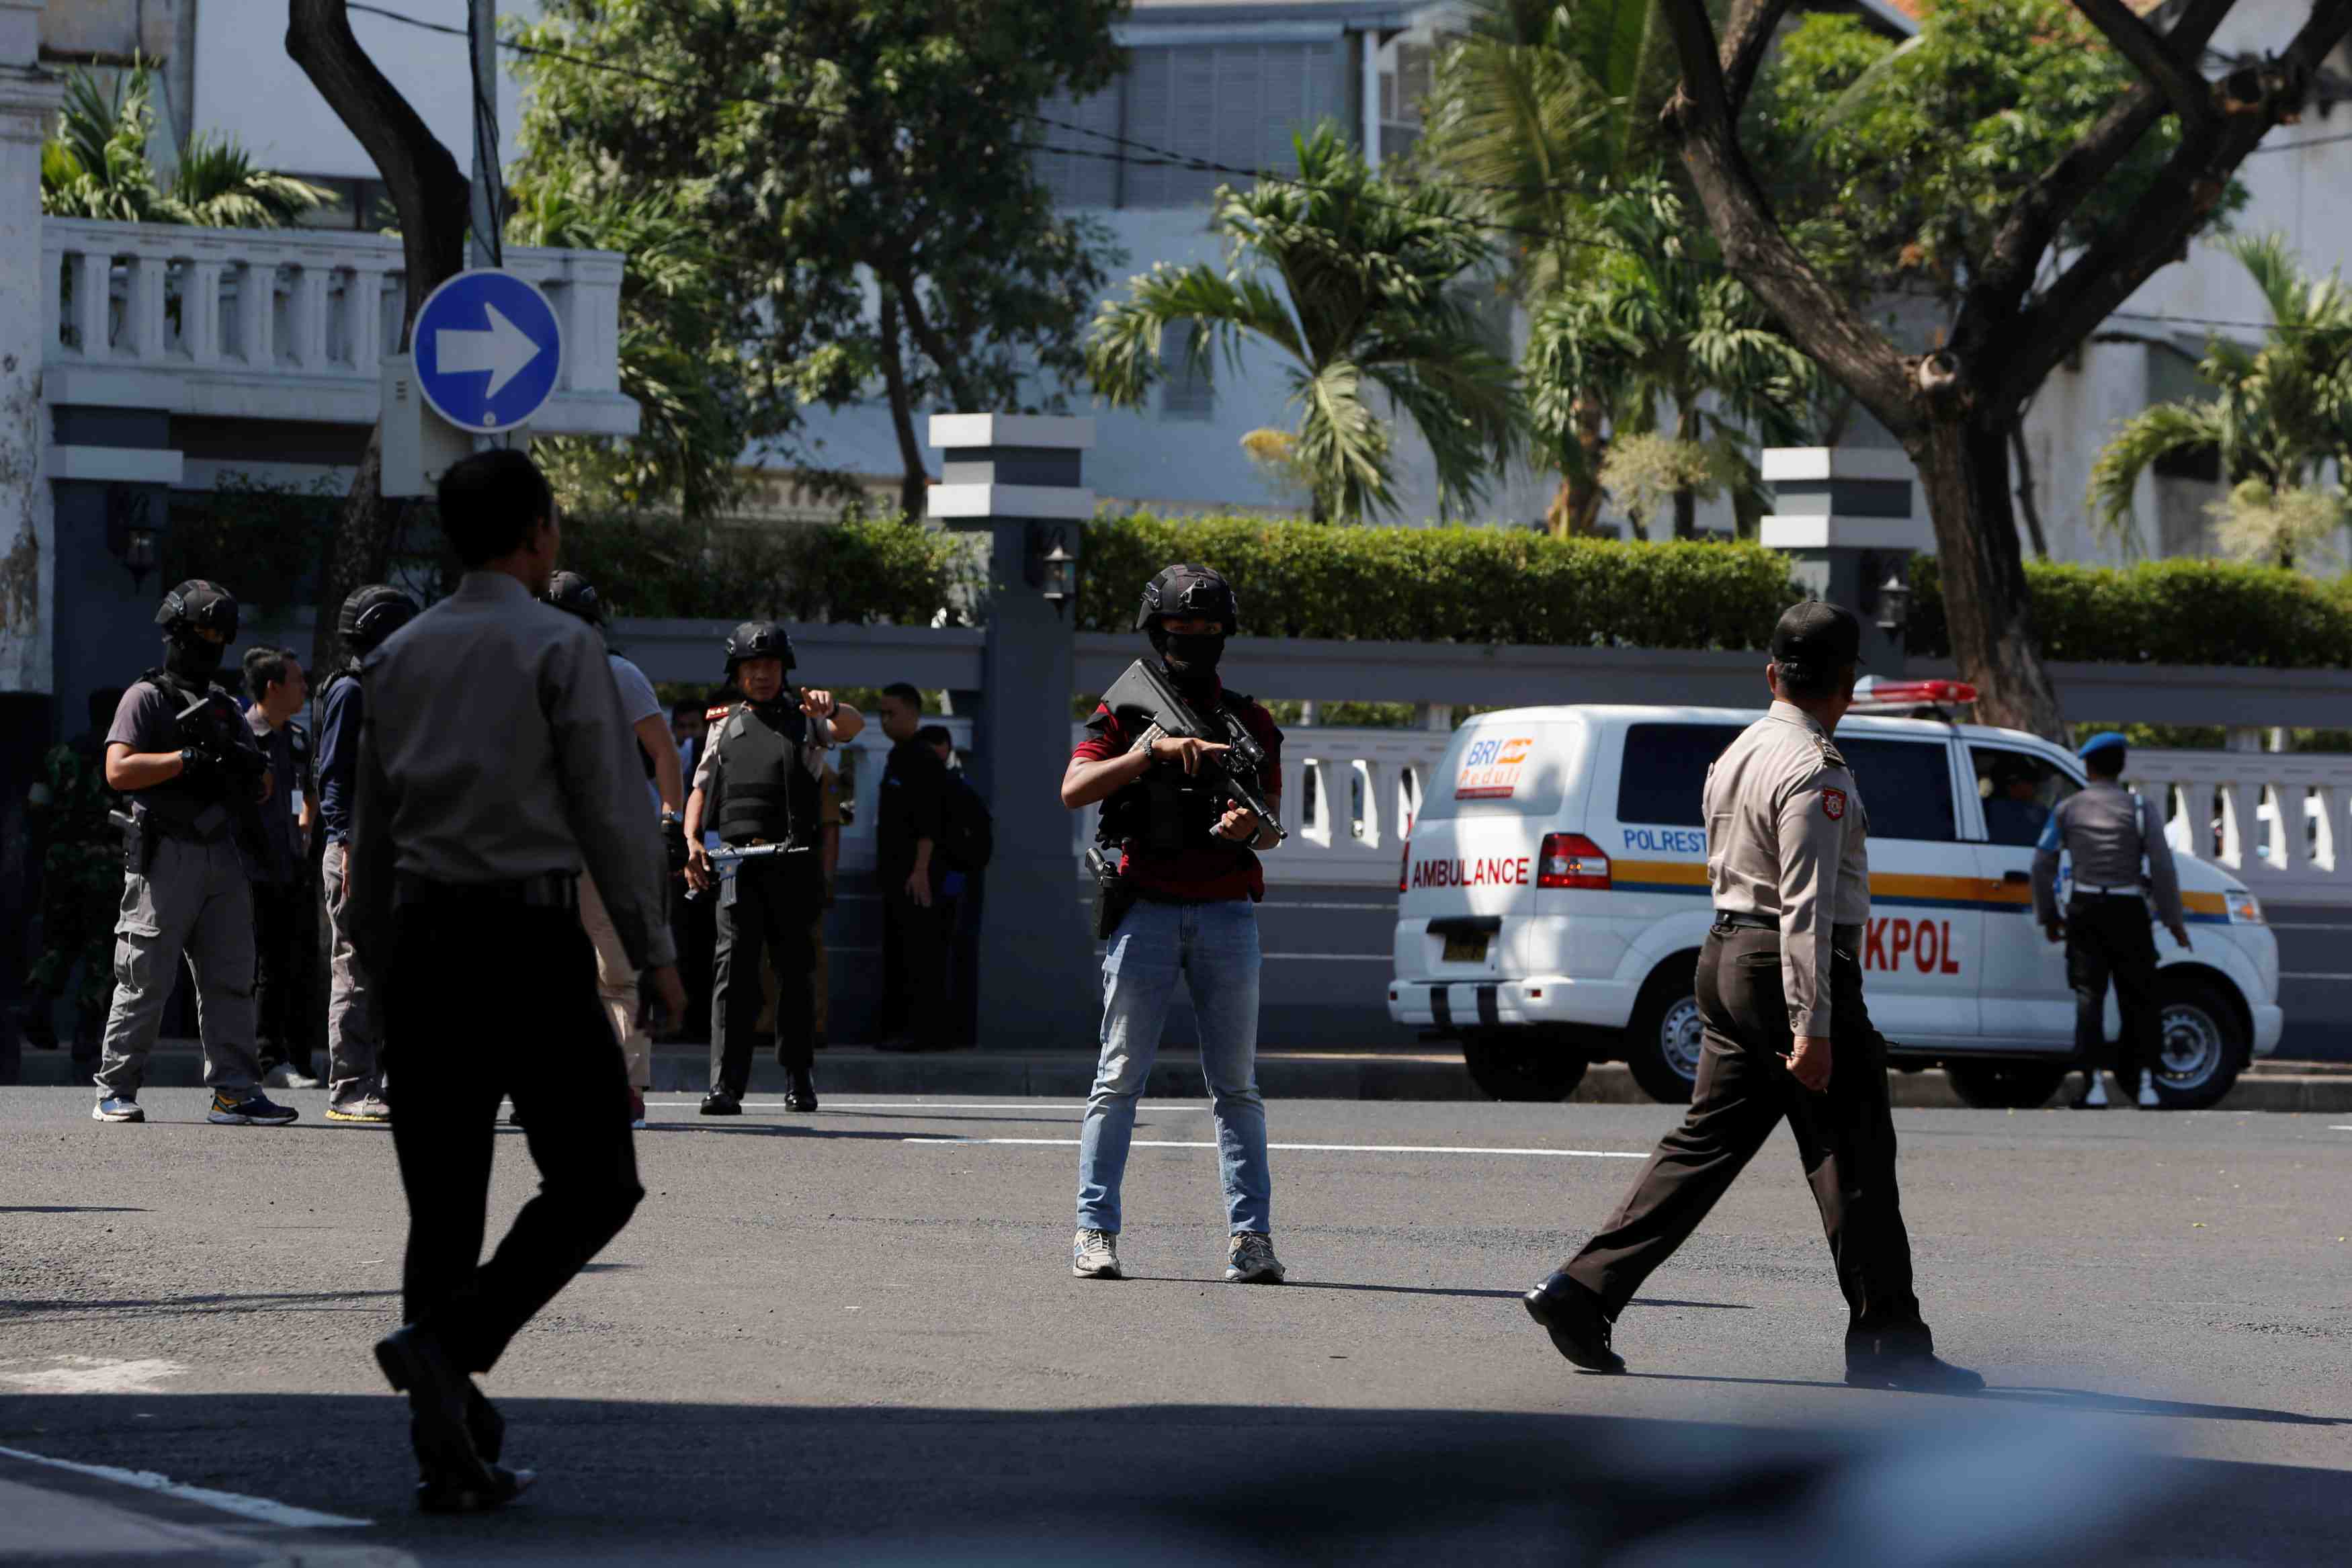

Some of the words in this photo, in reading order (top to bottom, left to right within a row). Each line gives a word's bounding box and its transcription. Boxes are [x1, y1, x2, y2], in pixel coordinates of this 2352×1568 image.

[1467, 740, 1501, 765] BRI
[1412, 857, 1529, 888] AMBULANCE
[1857, 918, 1958, 973] KPOL
